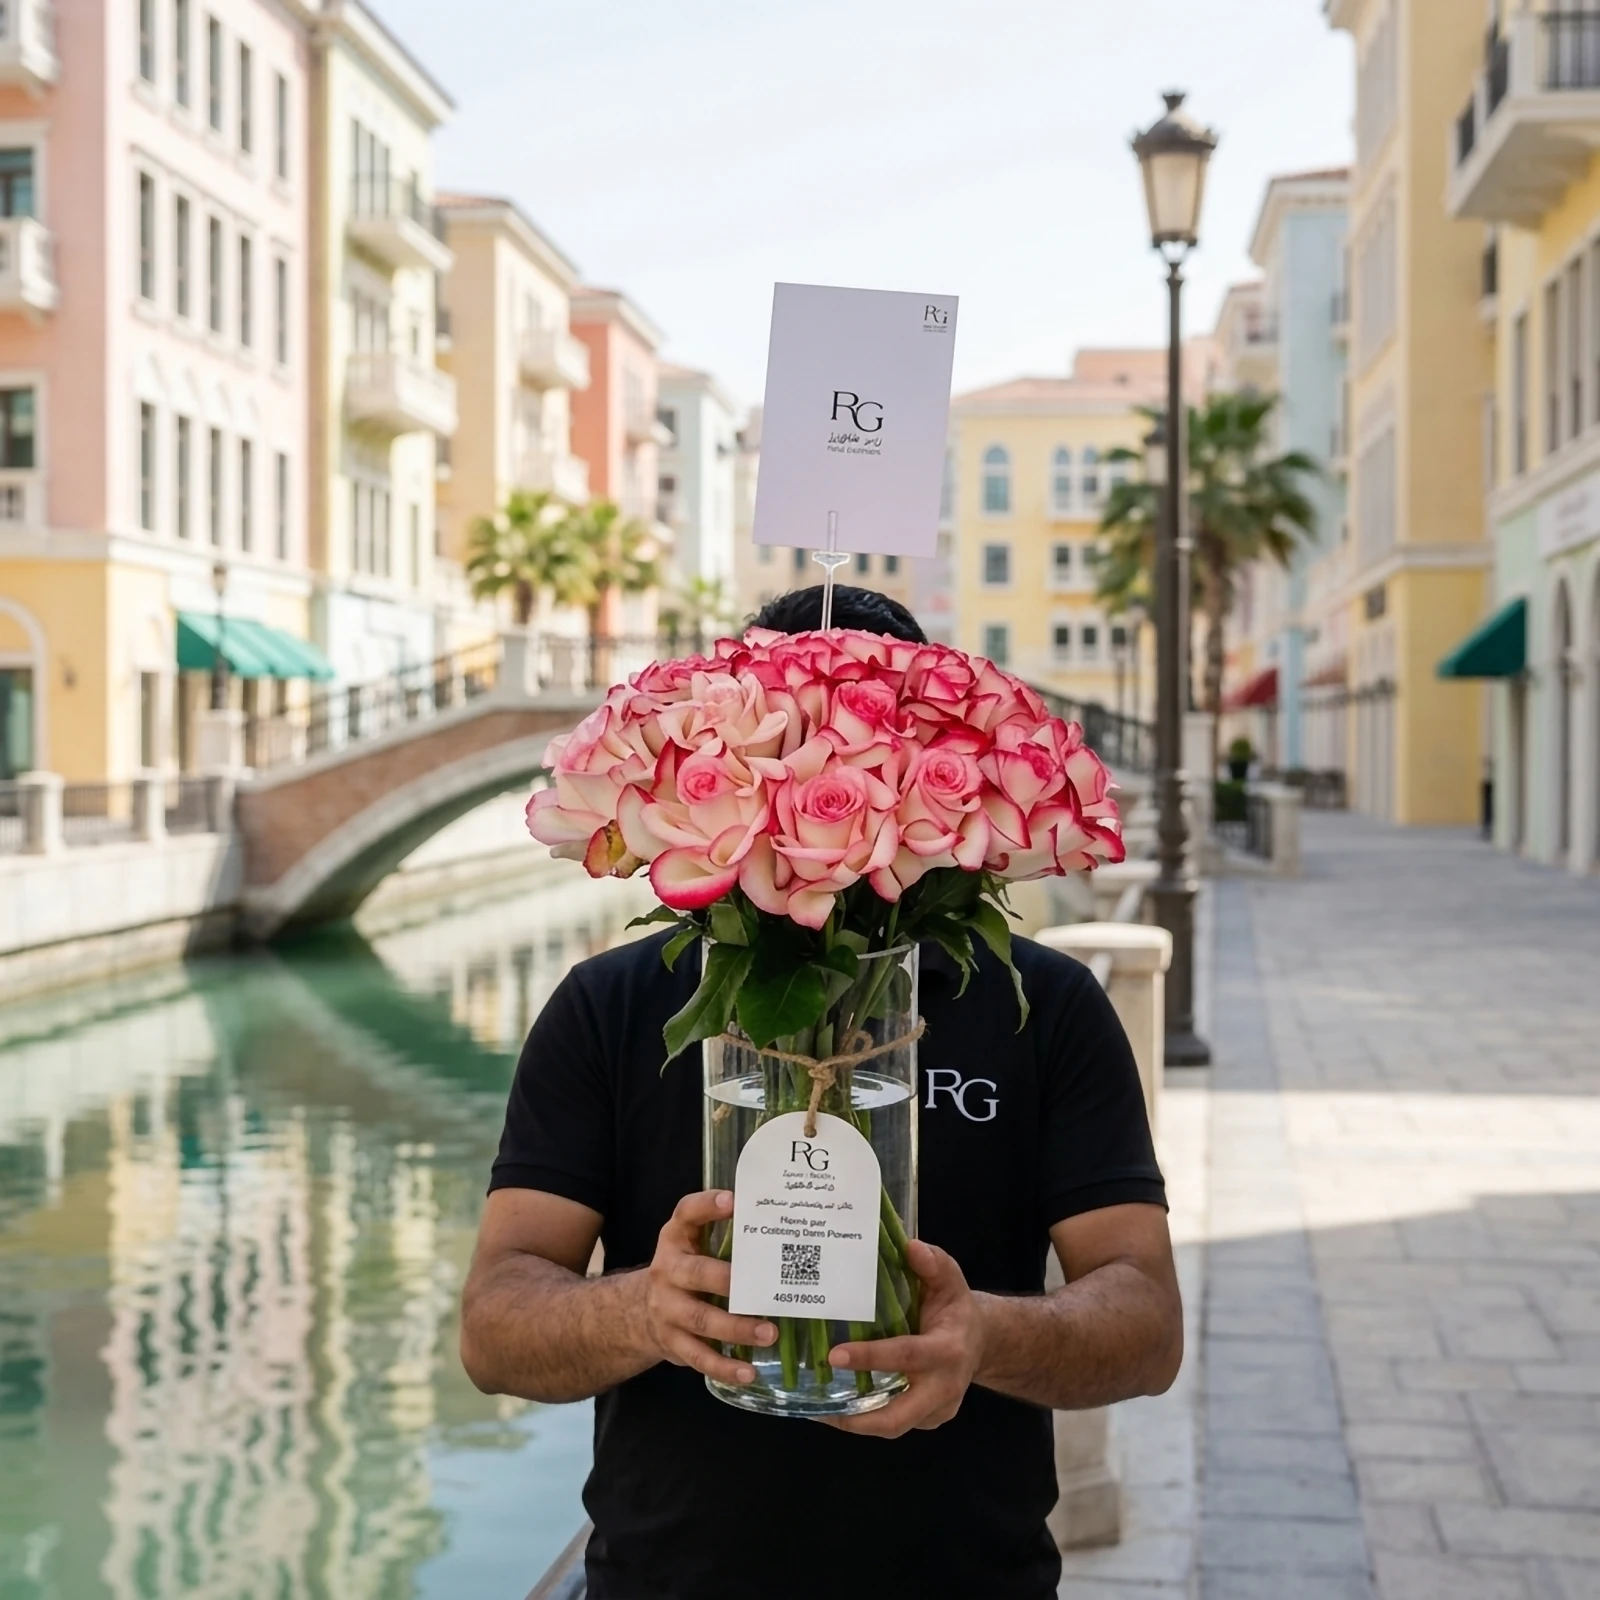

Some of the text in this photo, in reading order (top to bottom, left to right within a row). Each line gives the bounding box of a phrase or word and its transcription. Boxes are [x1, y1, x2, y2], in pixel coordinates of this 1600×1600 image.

[830, 390, 884, 433] RG
[924, 1068, 1000, 1122] RG
[790, 1140, 830, 1172] RG
